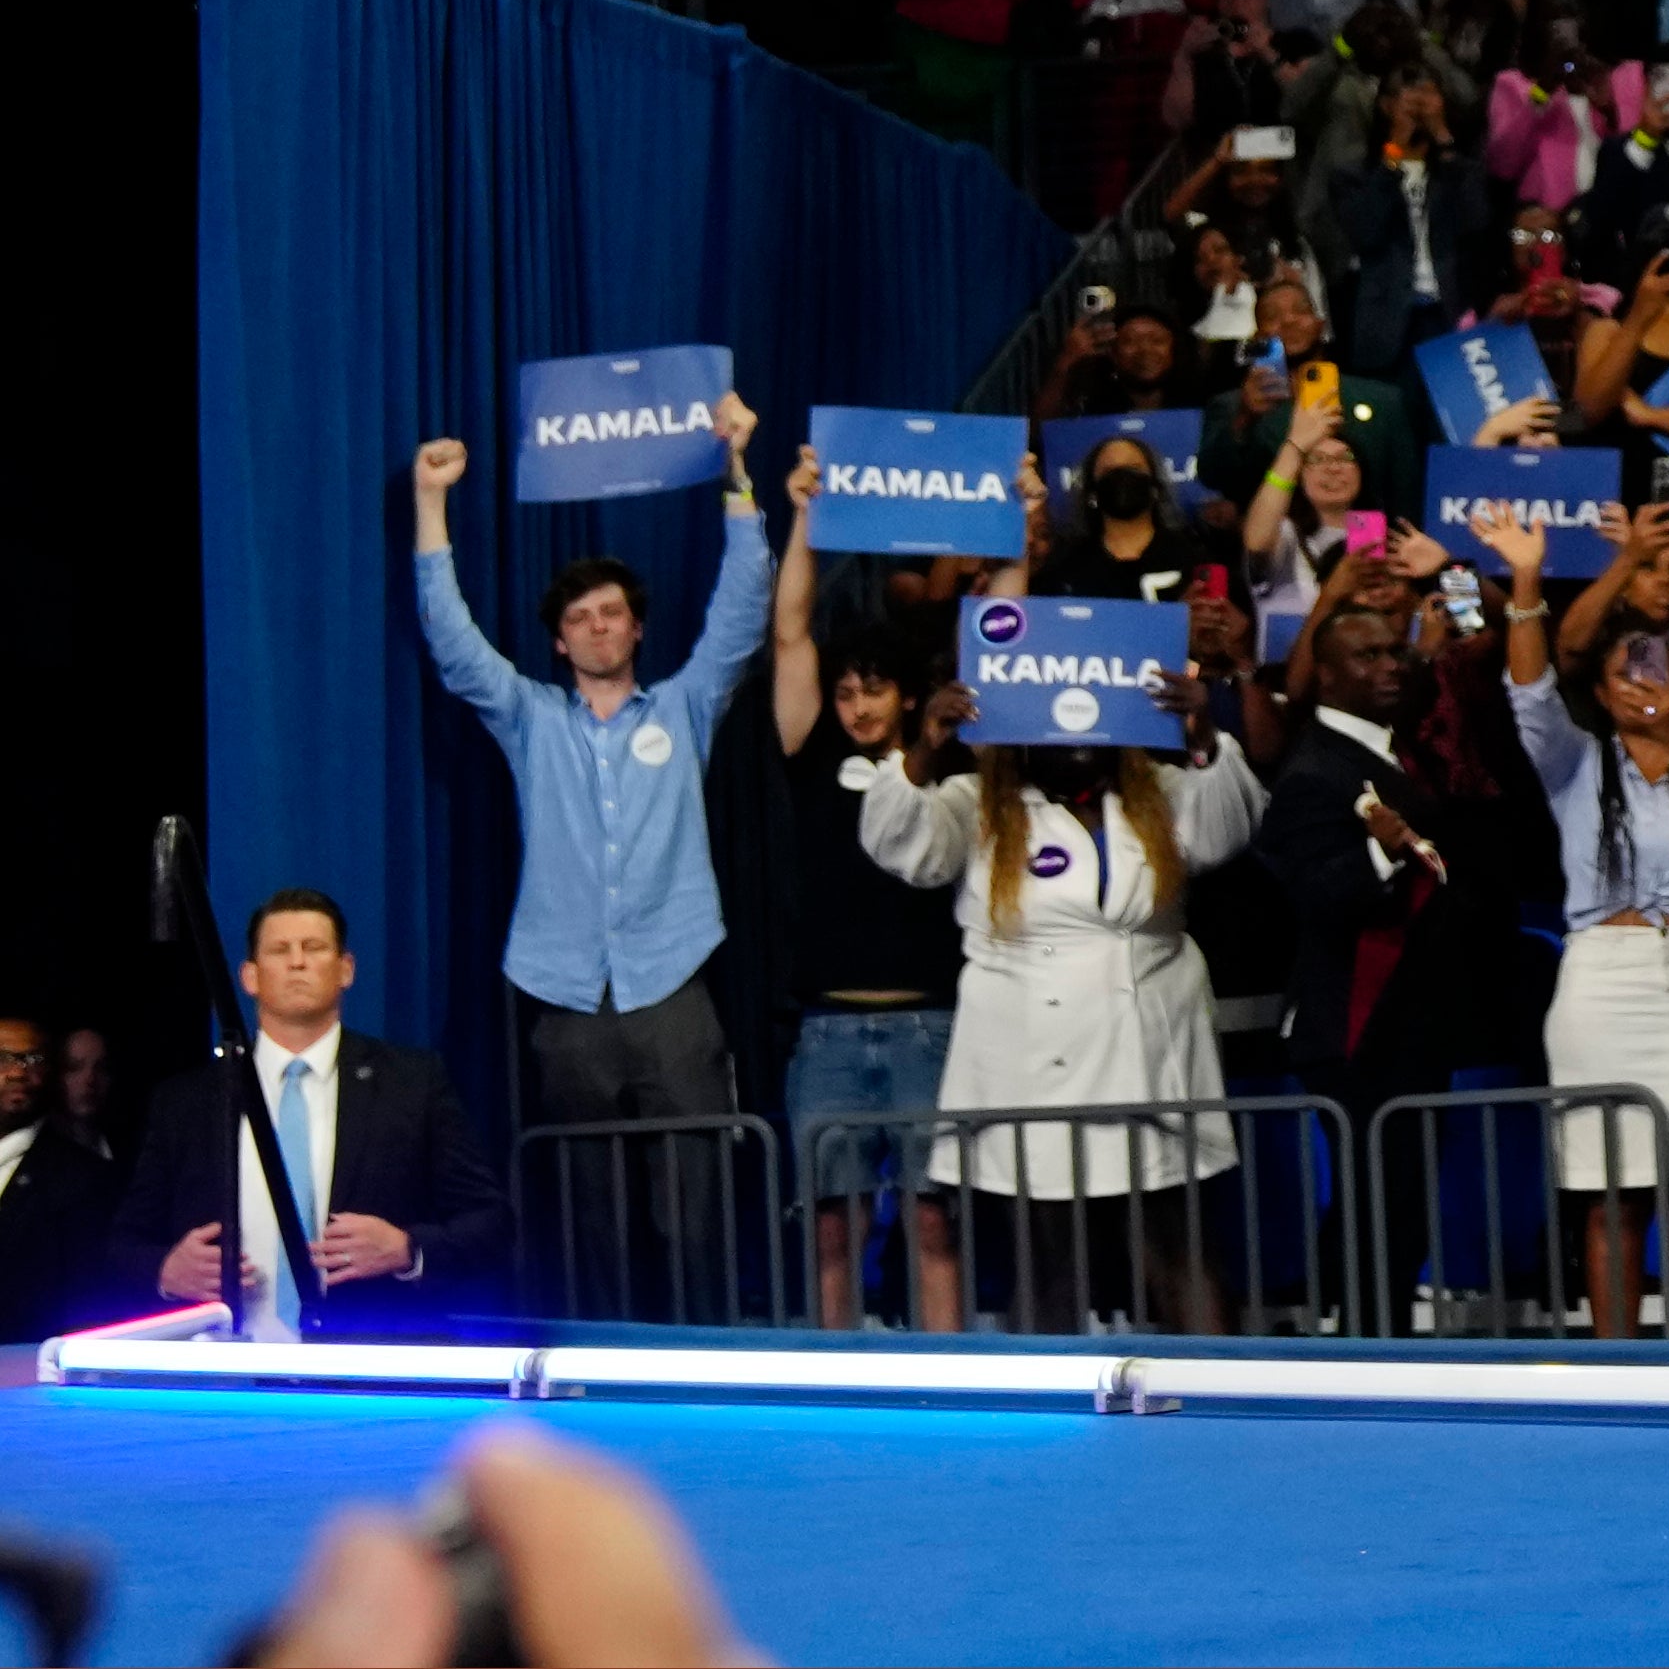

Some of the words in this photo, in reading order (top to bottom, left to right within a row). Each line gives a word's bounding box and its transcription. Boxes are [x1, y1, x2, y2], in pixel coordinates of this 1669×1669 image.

[538, 401, 712, 447] KAMALA
[829, 463, 1007, 502] KAMALA
[978, 653, 1163, 689] KAMALA
